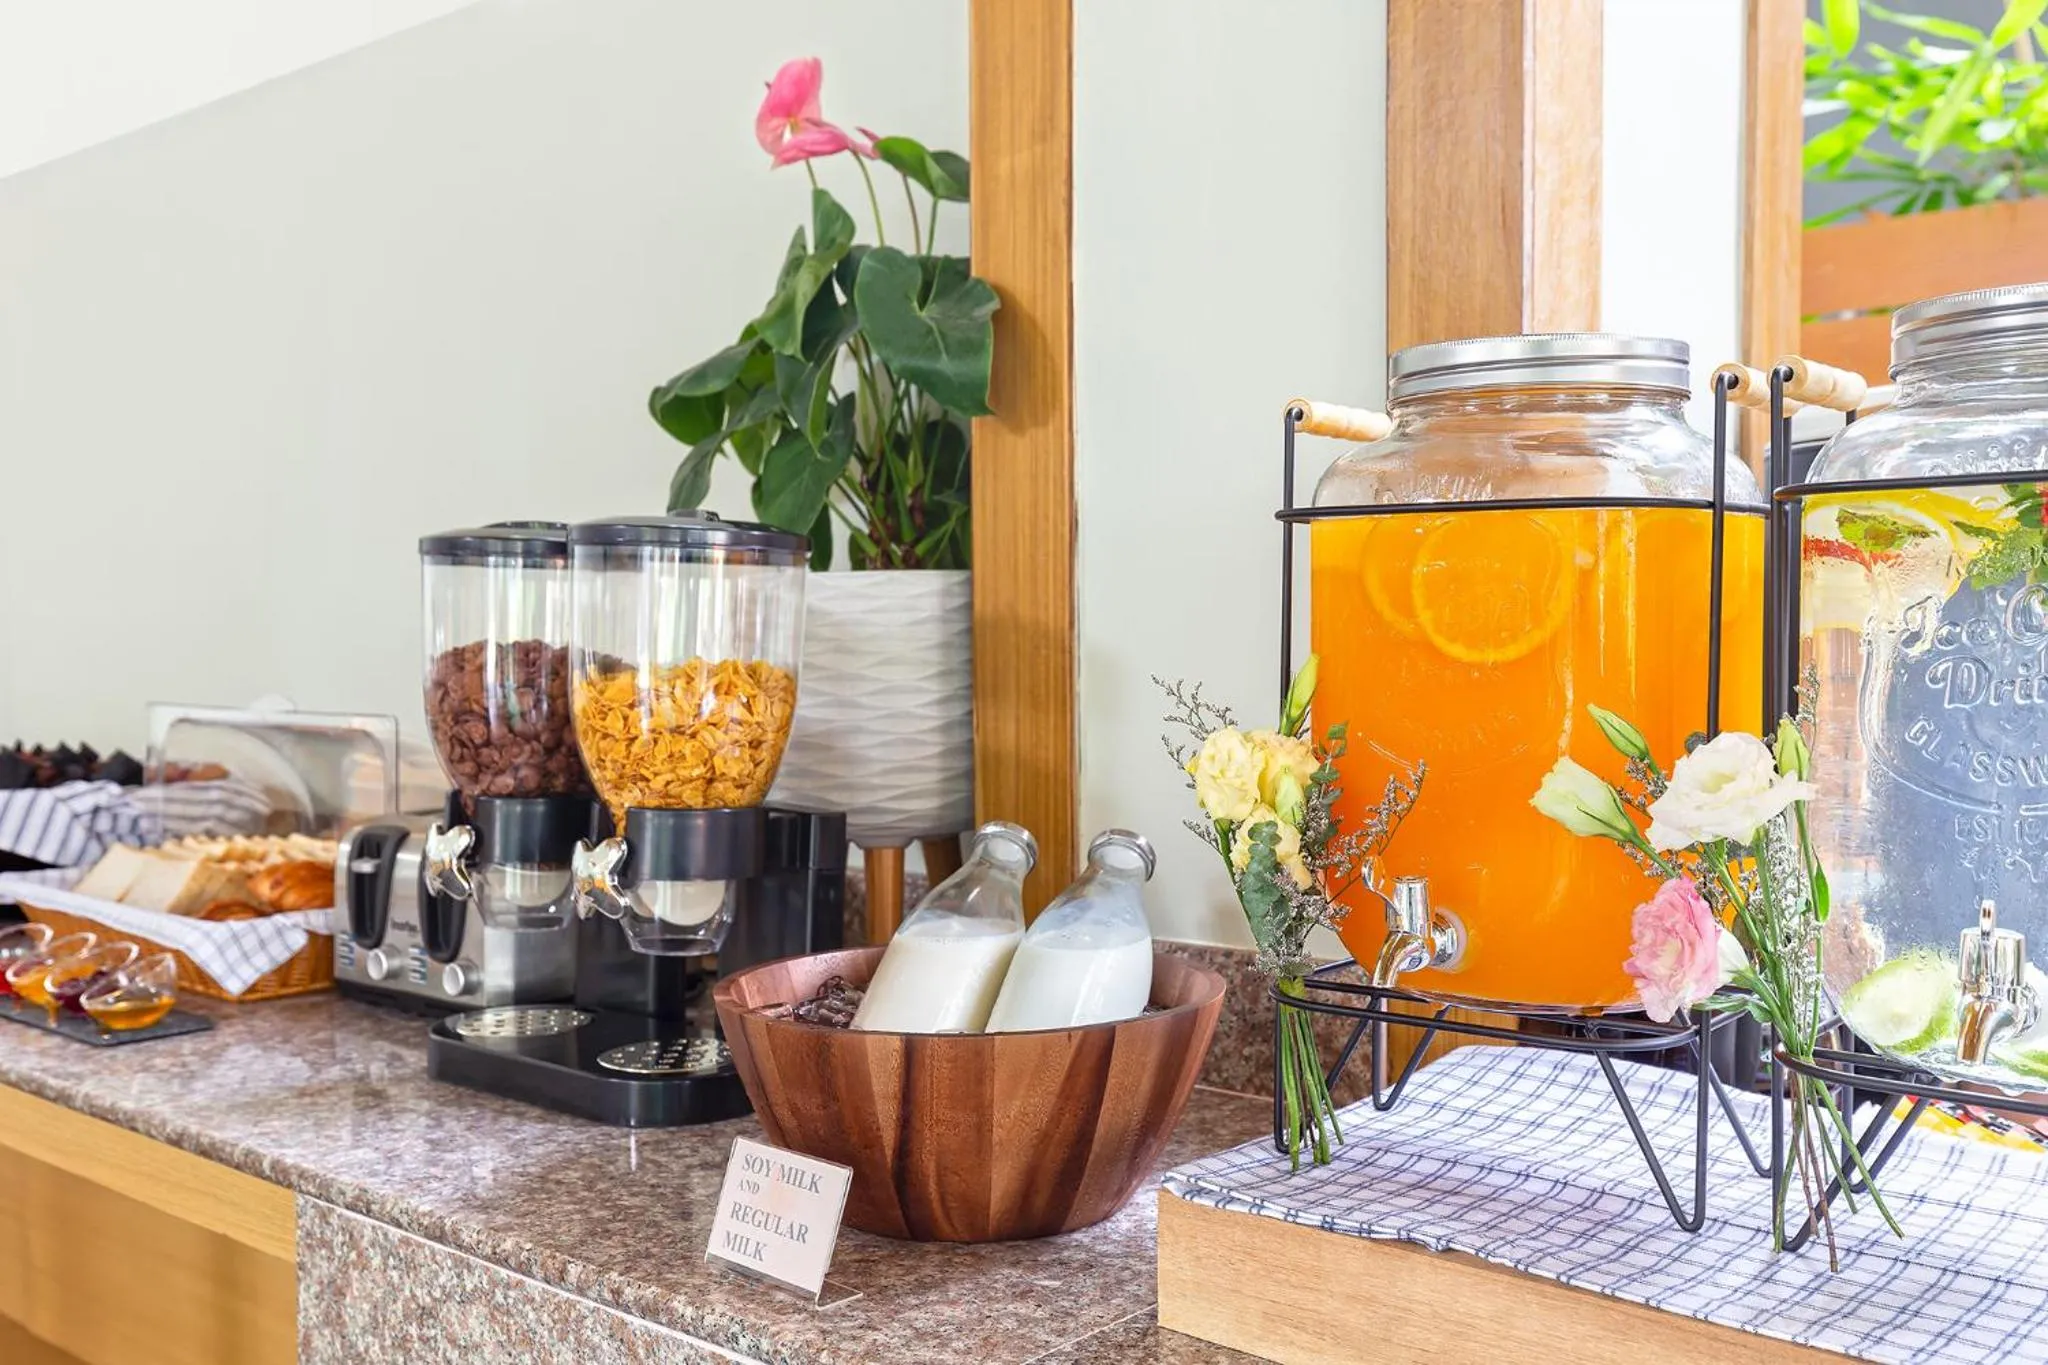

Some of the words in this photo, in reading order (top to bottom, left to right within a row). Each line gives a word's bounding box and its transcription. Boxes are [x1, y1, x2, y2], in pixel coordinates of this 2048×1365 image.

[738, 1180, 759, 1194] AND
[742, 1153, 775, 1177] SOY
[776, 1164, 822, 1193] MILK
[731, 1202, 808, 1244] REGULAR
[723, 1231, 767, 1261] MILK
